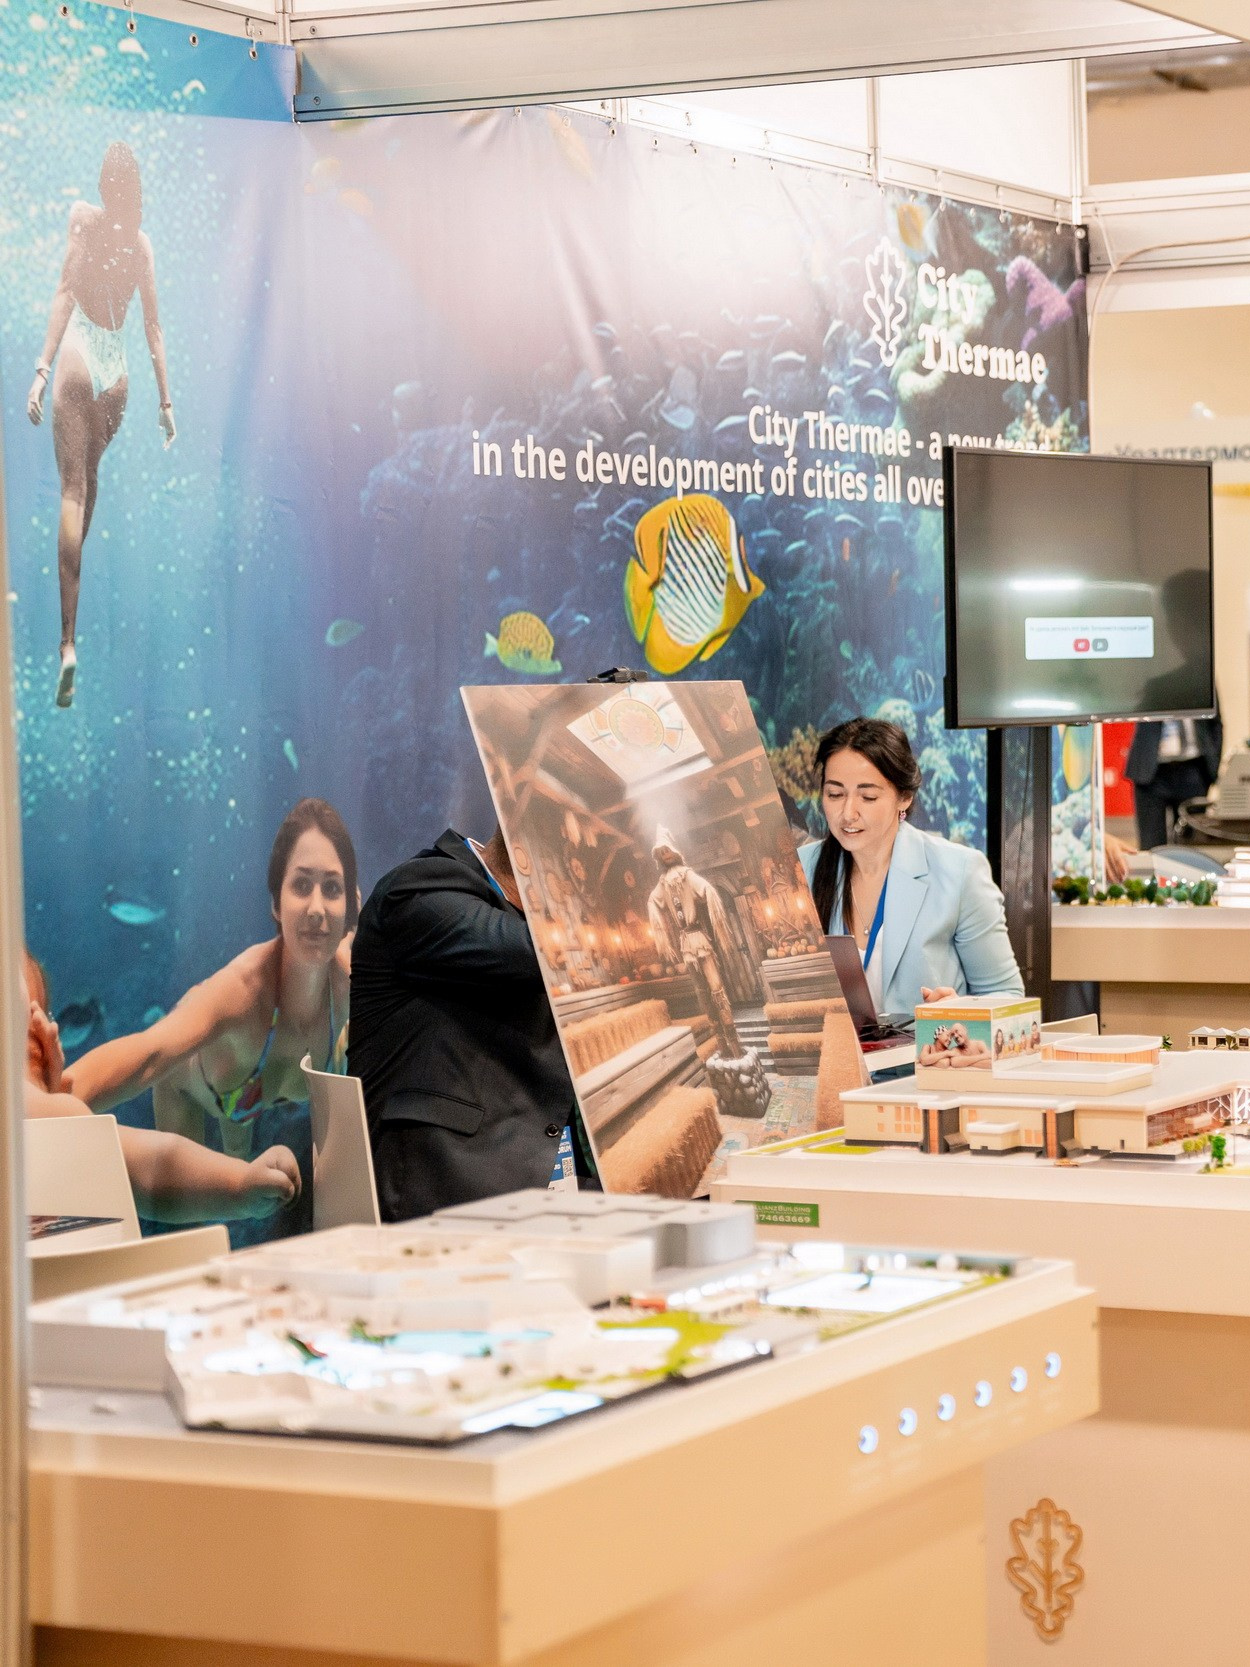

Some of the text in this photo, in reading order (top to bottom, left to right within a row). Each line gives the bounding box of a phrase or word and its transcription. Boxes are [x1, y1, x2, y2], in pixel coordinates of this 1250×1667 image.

[917, 262, 978, 325] City
[917, 322, 1048, 385] Thermae
[748, 404, 798, 458] City
[803, 410, 912, 458] Thermae
[928, 430, 943, 460] a
[472, 429, 944, 507] in the development of cities all ove
